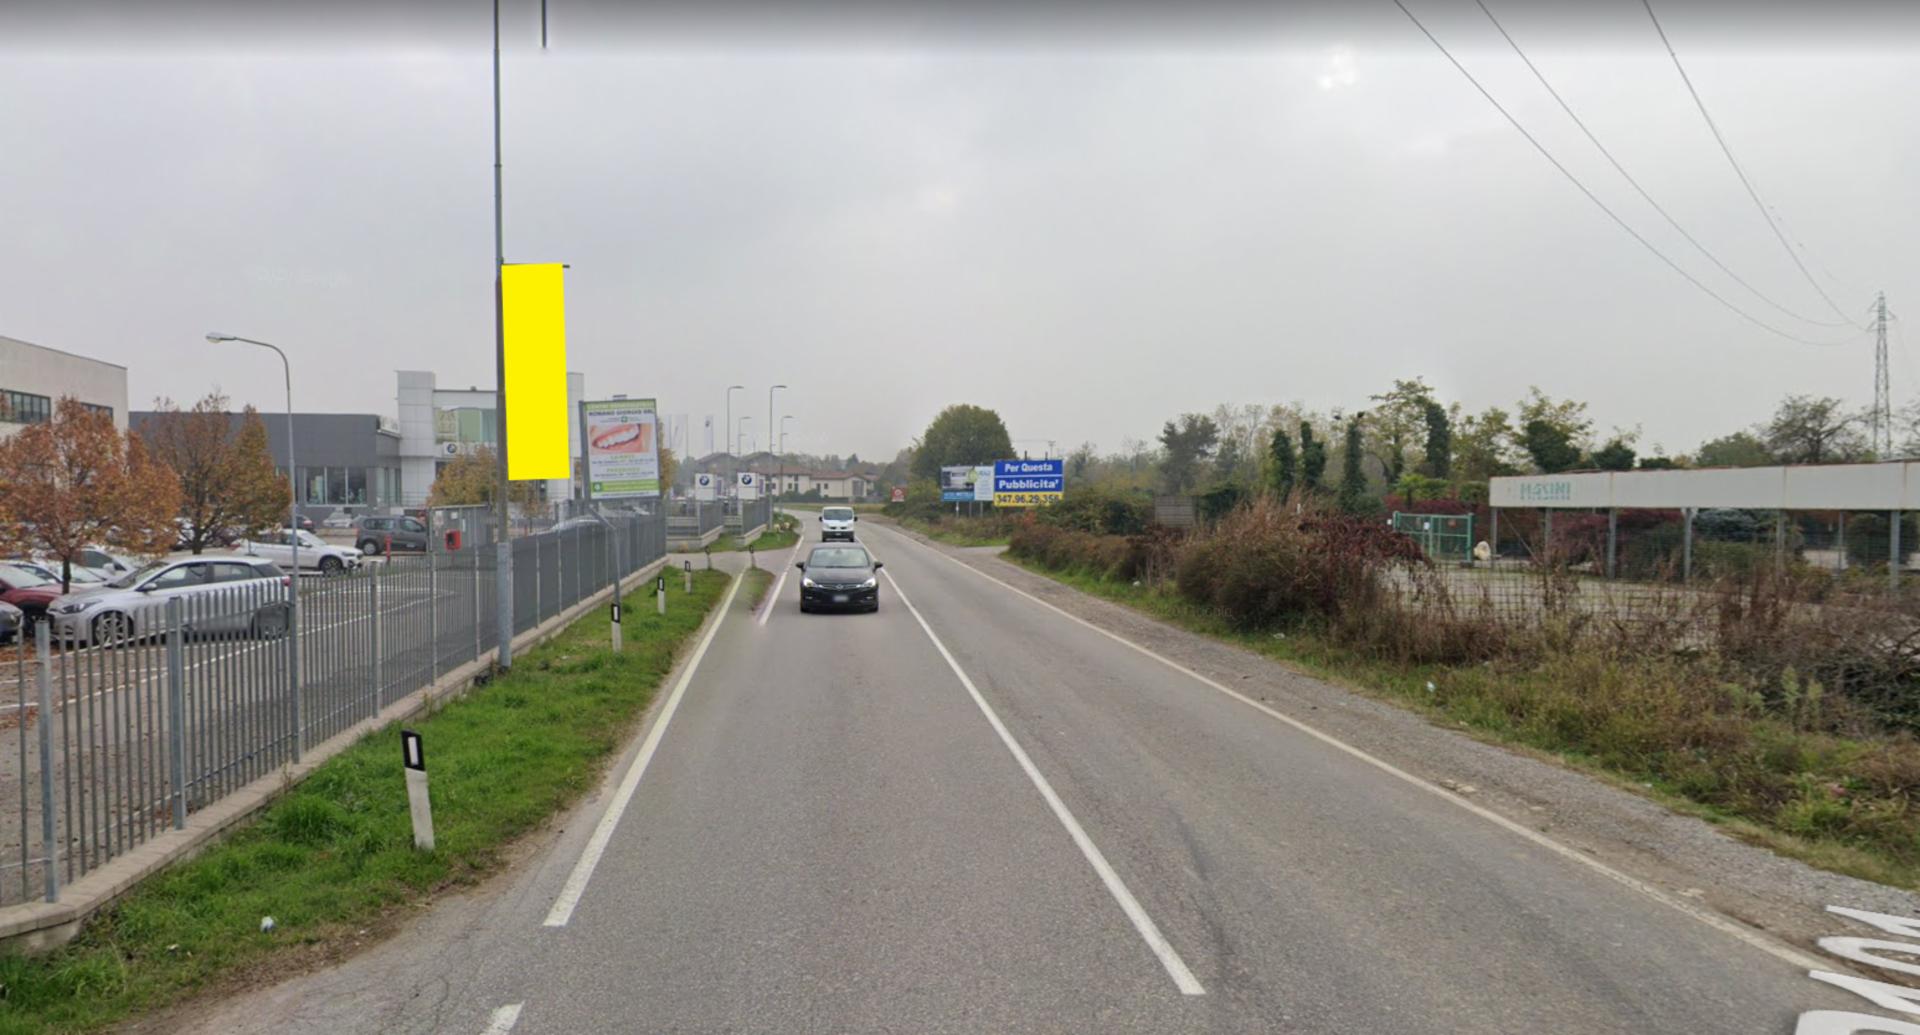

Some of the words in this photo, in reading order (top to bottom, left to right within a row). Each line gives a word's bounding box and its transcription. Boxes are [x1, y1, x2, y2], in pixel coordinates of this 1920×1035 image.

[1004, 463, 1019, 472] Per
[1021, 462, 1053, 472] Questa
[998, 479, 1059, 489] Pubblicita'
